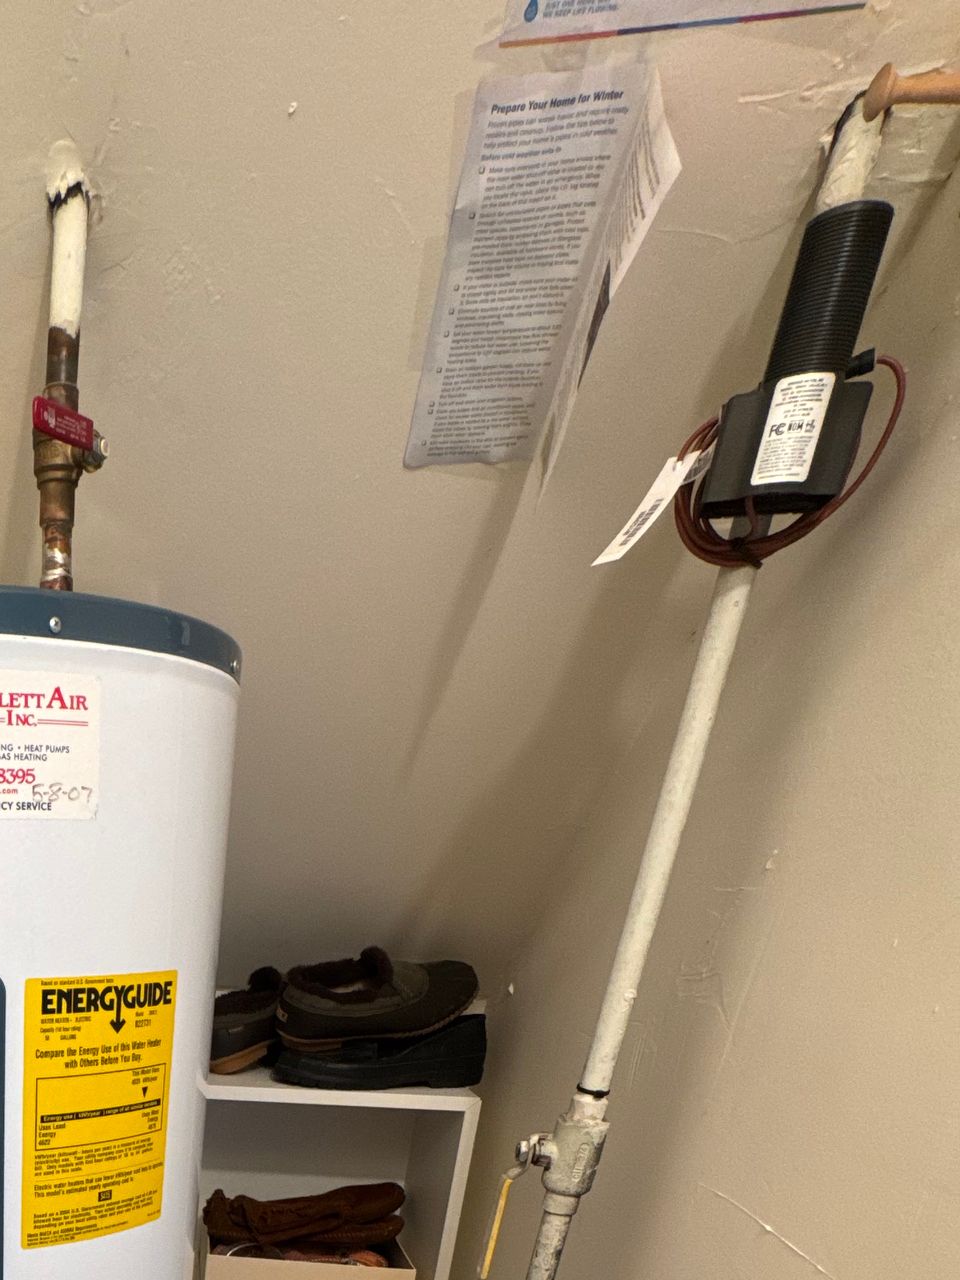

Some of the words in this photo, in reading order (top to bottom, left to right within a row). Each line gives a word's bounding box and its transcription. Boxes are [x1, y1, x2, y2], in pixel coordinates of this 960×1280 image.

[491, 104, 526, 116] Prepare
[528, 100, 548, 111] Your
[549, 96, 576, 109] Home
[577, 93, 592, 104] for
[593, 90, 625, 102] Winter
[24, 744, 43, 752] HEAT
[45, 745, 70, 754] PUMPS
[13, 753, 48, 762] HEATING
[15, 801, 52, 811] SERVICE
[41, 981, 173, 1016] ENERGYGUIDE
[35, 1049, 65, 1060] Compare
[67, 1047, 77, 1056] the
[79, 1046, 99, 1057] Energy
[101, 1044, 112, 1054] Use
[113, 1043, 119, 1052] of
[120, 1042, 130, 1051] this
[132, 1040, 146, 1050] Water
[147, 1039, 161, 1048] Heater
[64, 1060, 78, 1069] with
[80, 1058, 99, 1068] Others
[100, 1056, 119, 1066] Before
[120, 1054, 130, 1063] You
